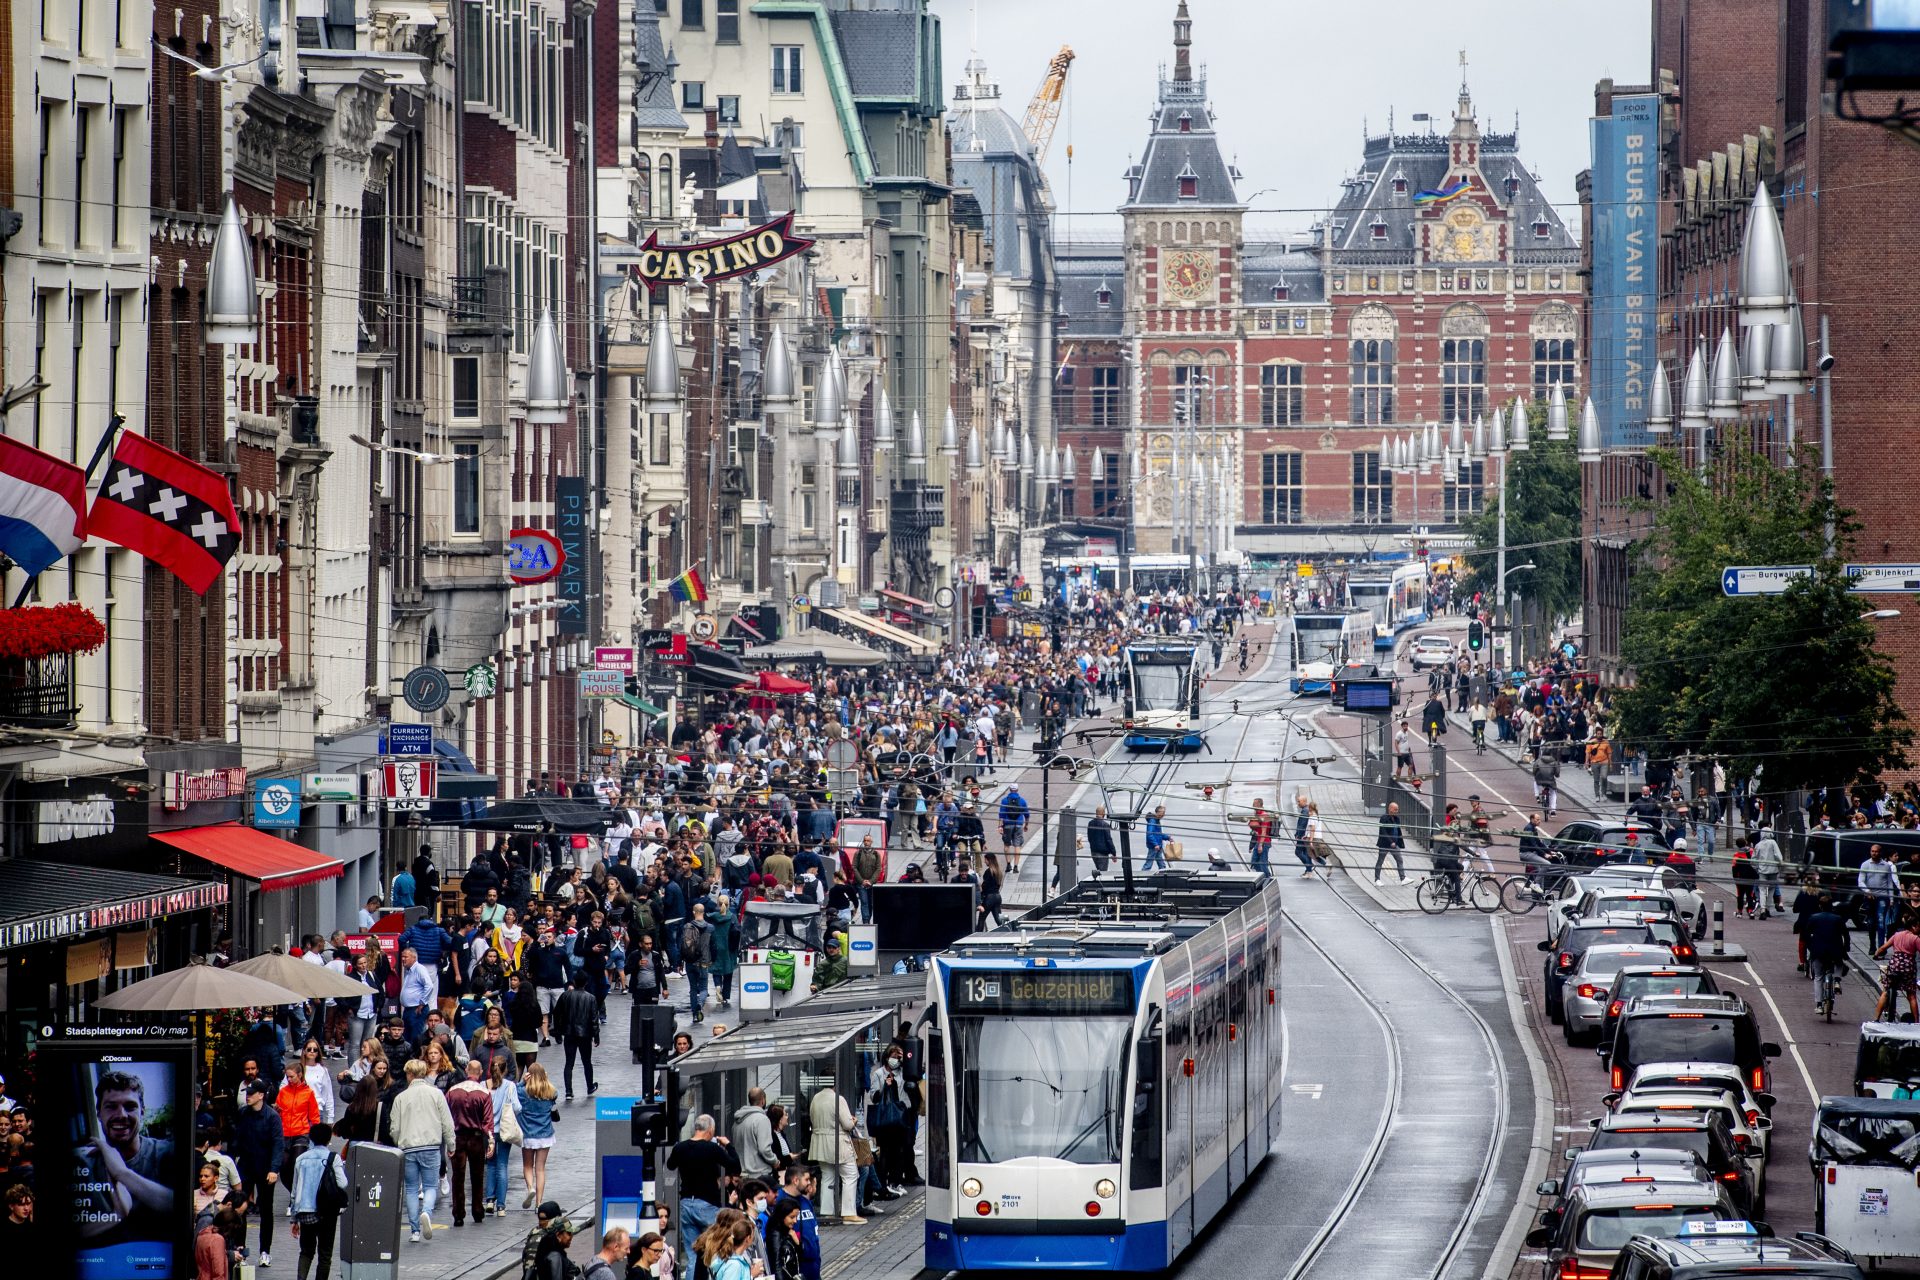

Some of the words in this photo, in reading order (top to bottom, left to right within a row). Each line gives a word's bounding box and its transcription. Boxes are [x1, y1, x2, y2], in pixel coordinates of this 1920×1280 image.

[1625, 134, 1643, 218] BEURS
[639, 230, 784, 279] CASINO
[1625, 230, 1643, 283] VAN
[1625, 295, 1643, 410] BERLAGE
[509, 543, 552, 569] C&A
[563, 495, 580, 615] PRIMARK
[1875, 569, 1913, 577] Bijenkorf
[597, 662, 632, 670] WORLDS
[584, 685, 621, 693] HOUSE
[587, 674, 618, 683] TULIP
[394, 798, 424, 809] KFC
[152, 896, 163, 917] DE
[965, 977, 986, 1002] 13
[65, 1026, 143, 1037] Stadsplattegrond
[150, 1026, 168, 1036] City
[168, 1027, 188, 1036] map
